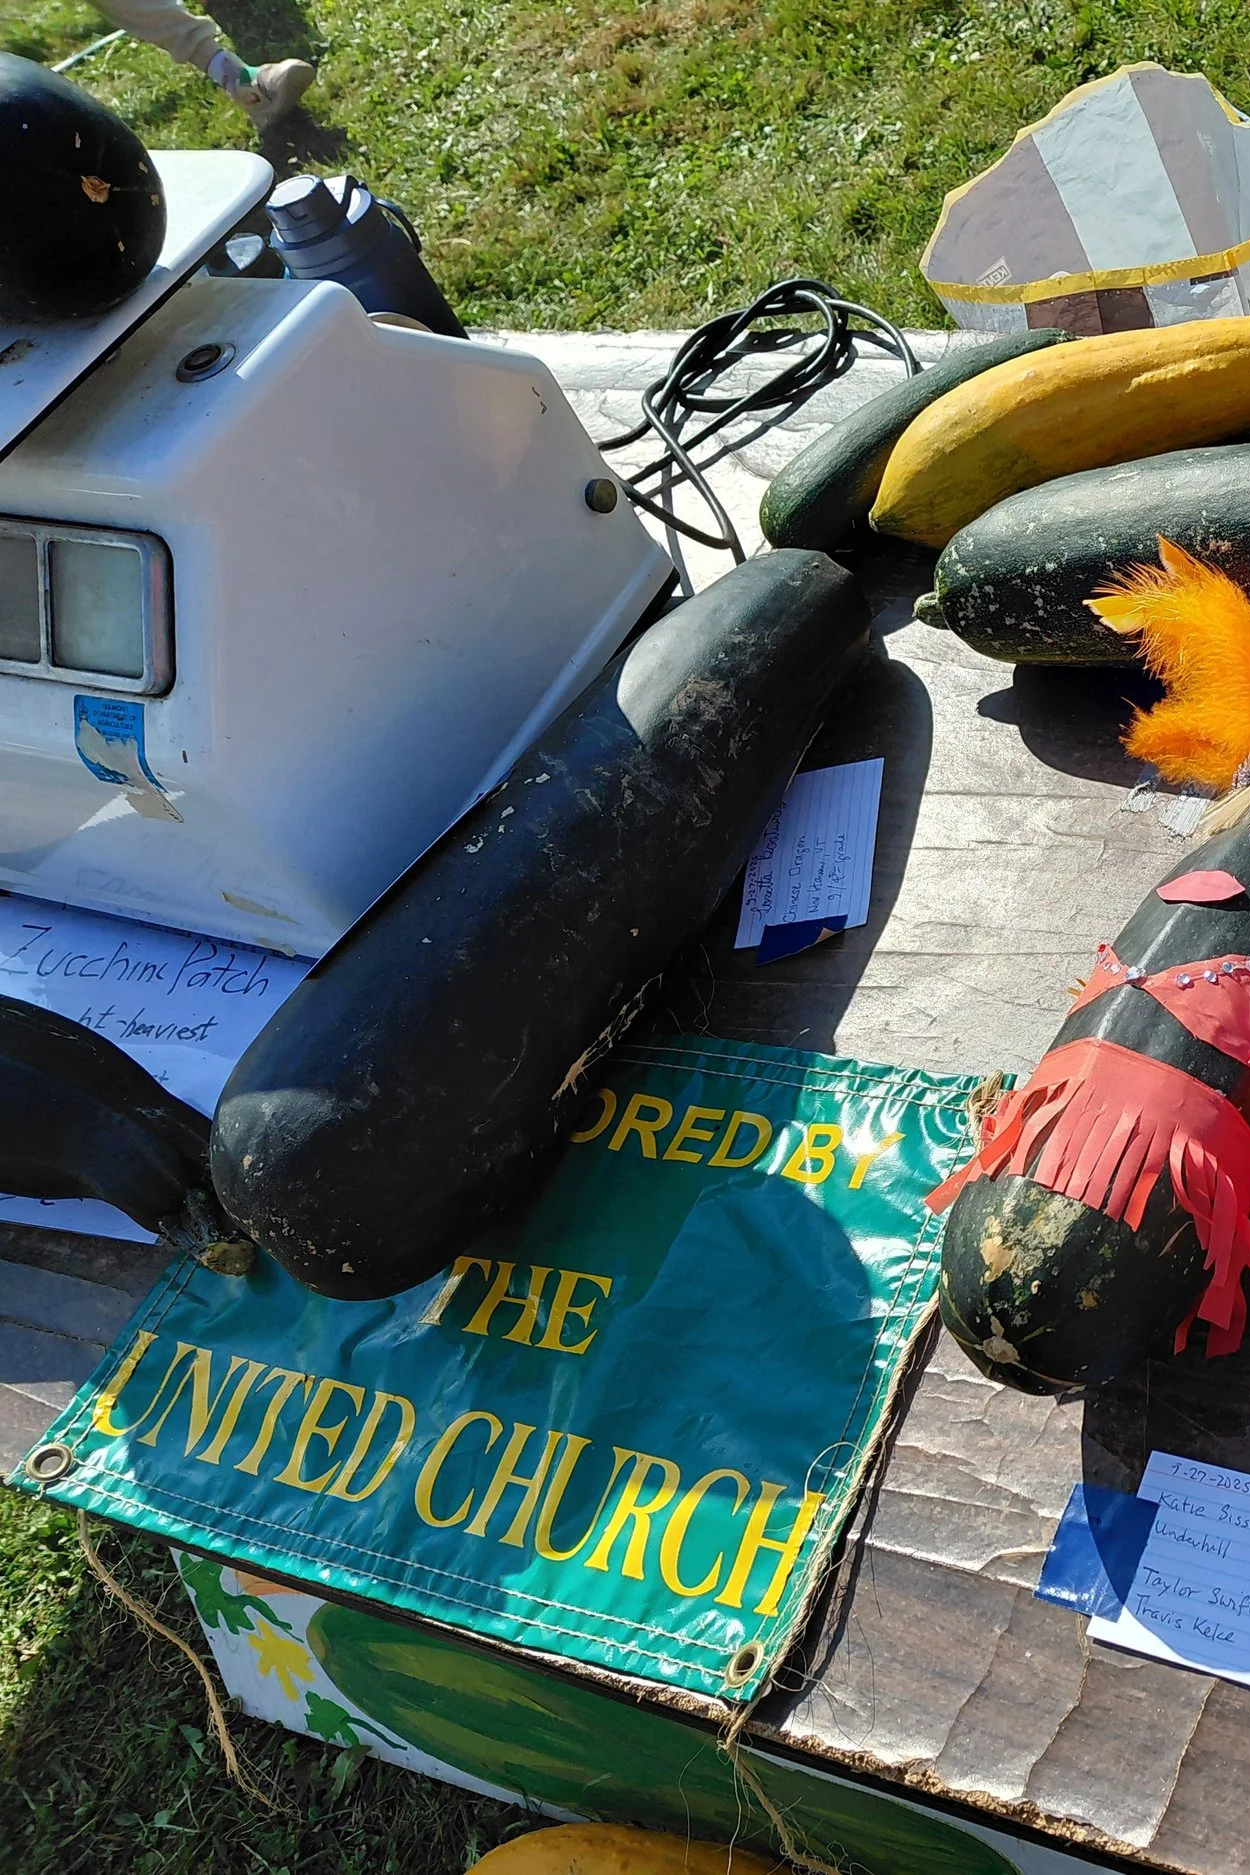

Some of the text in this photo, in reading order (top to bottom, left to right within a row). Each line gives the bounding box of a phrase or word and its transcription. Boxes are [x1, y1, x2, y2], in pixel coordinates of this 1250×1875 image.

[782, 835, 811, 923] Chinese Dragon
[168, 941, 269, 996] Patch
[780, 1123, 906, 1190] BY
[418, 1256, 613, 1355] THE
[94, 1331, 826, 1617] UNITED CHURCH
[1159, 1491, 1206, 1518] Katie
[1155, 1520, 1231, 1558] Underhill
[1143, 1566, 1201, 1597] Taylor
[1135, 1593, 1182, 1629] Travis
